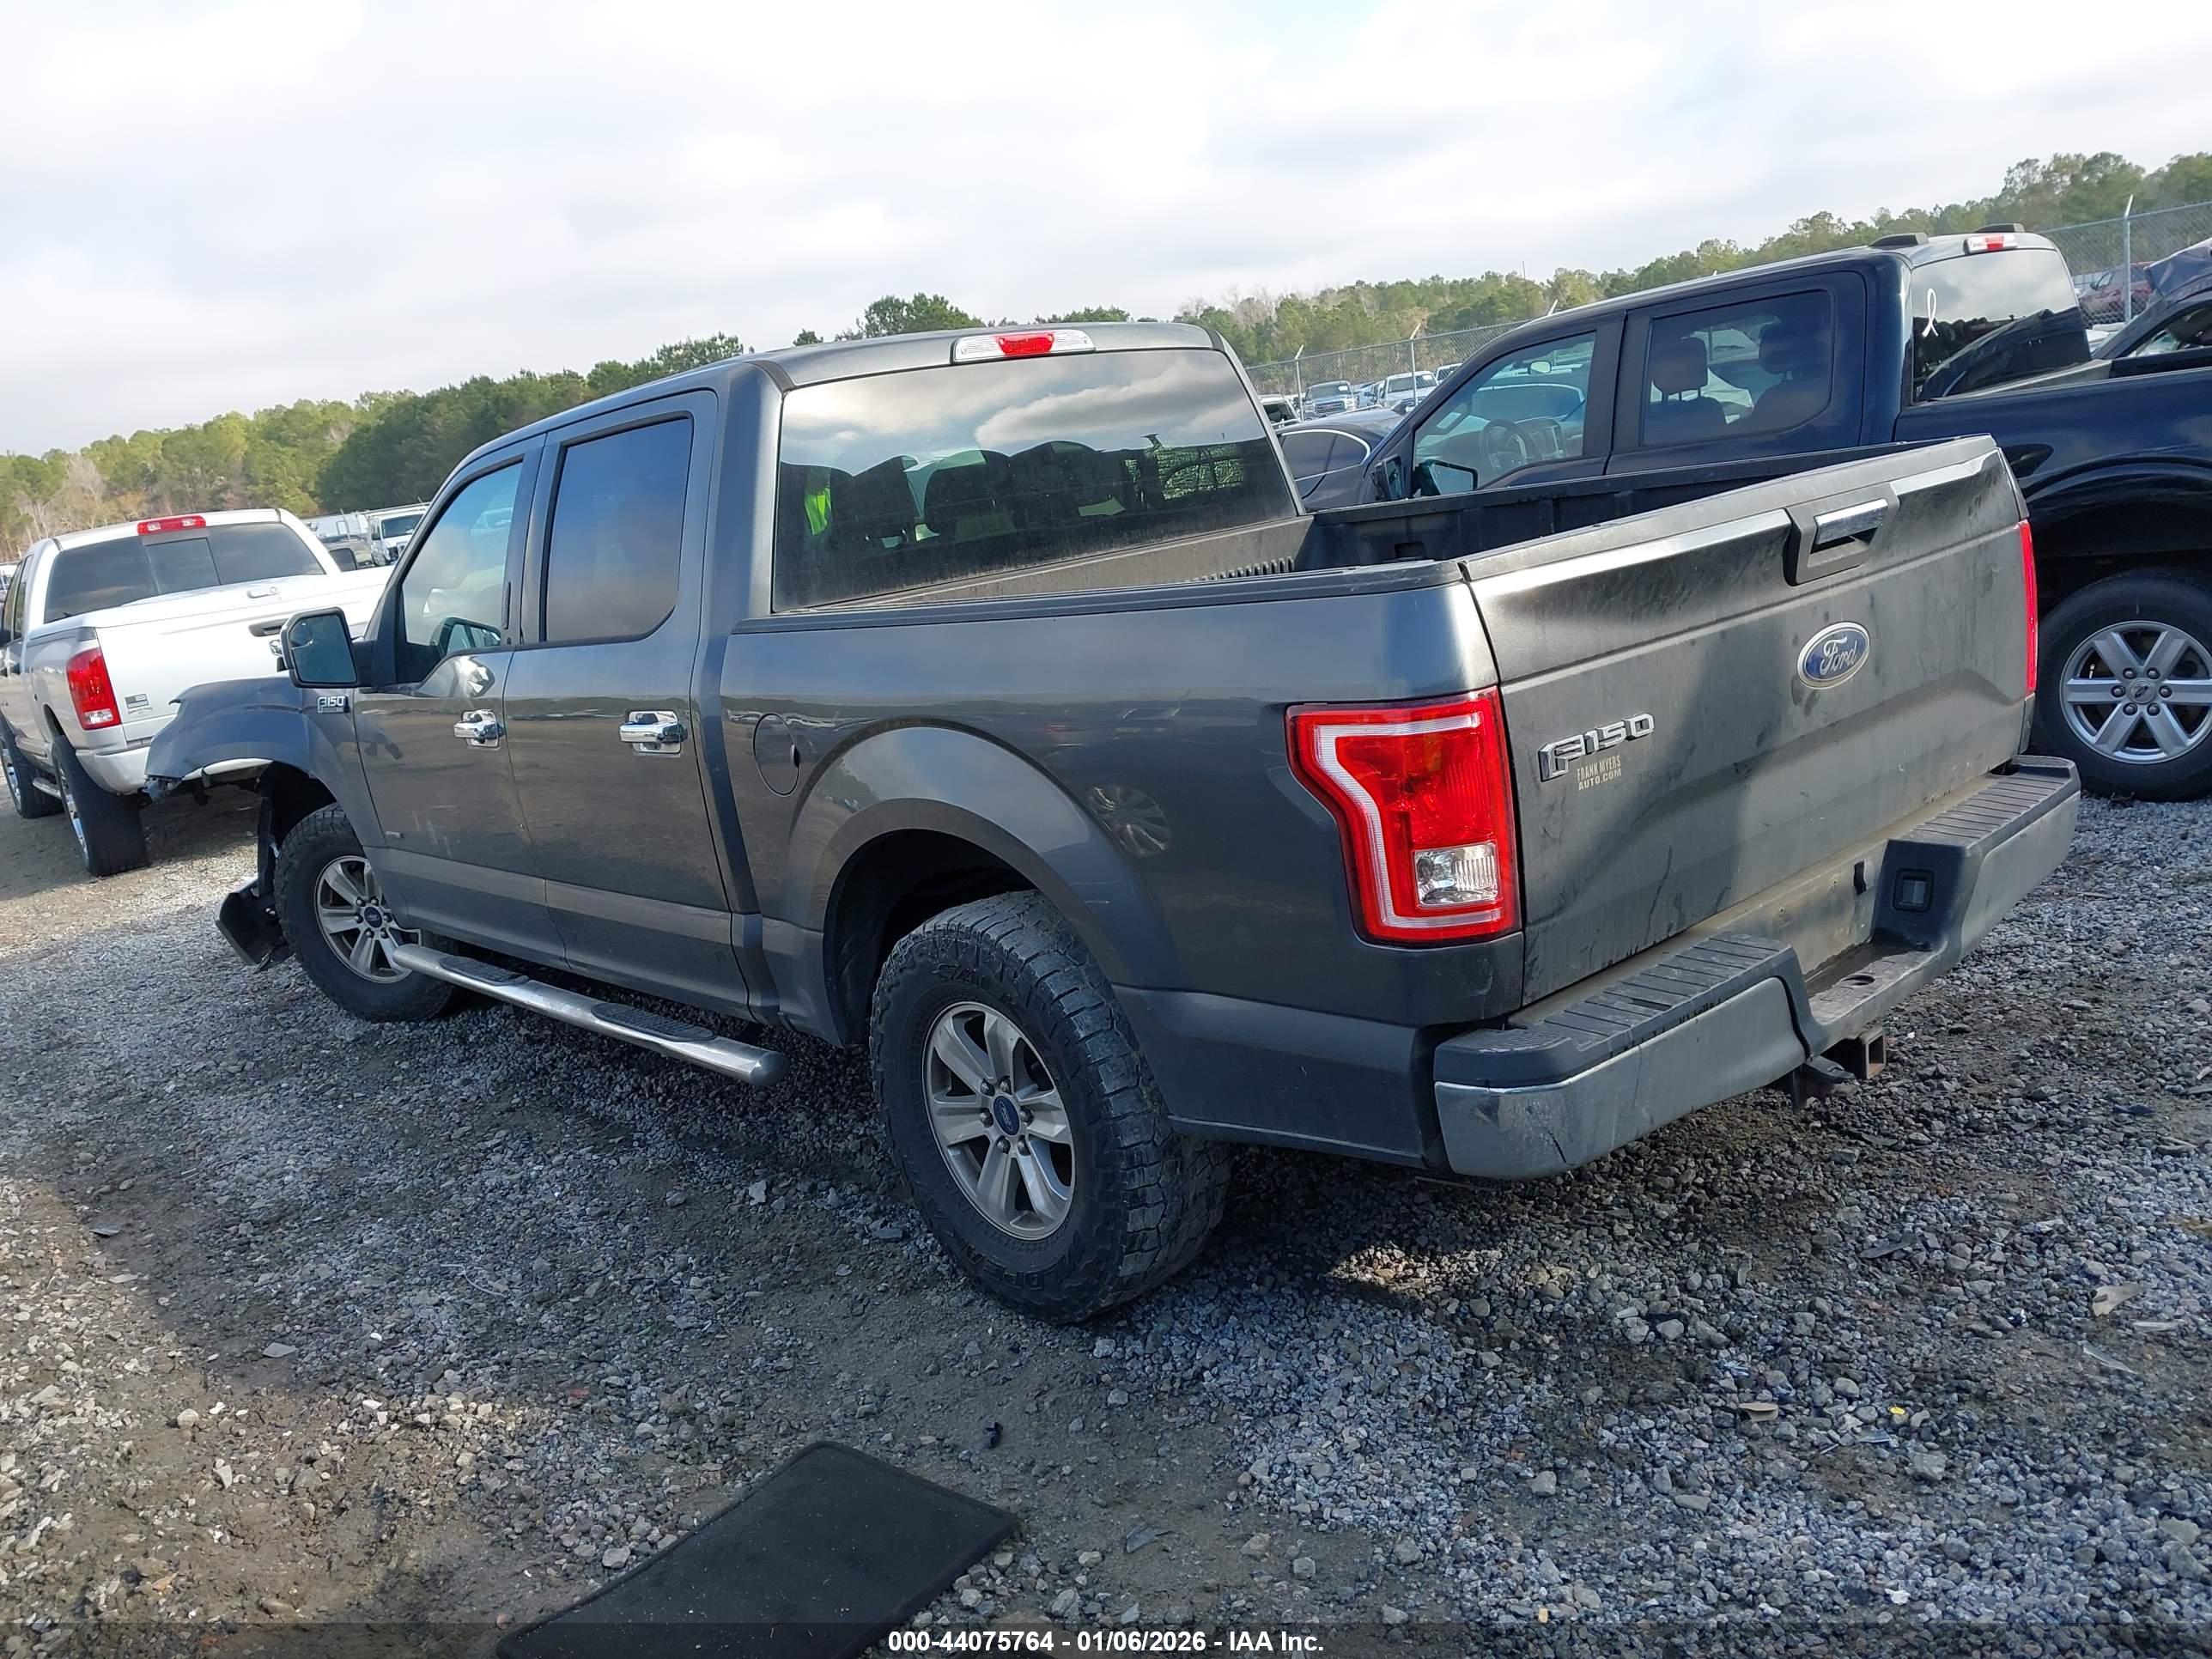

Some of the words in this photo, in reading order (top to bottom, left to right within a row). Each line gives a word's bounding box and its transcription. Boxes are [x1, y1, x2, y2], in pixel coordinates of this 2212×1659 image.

[1820, 635, 1857, 676] Ford
[1538, 713, 1655, 782] F150
[1577, 762, 1599, 781] FRANK
[1599, 754, 1621, 773] MYERS
[1578, 768, 1622, 791] AUTO.COM
